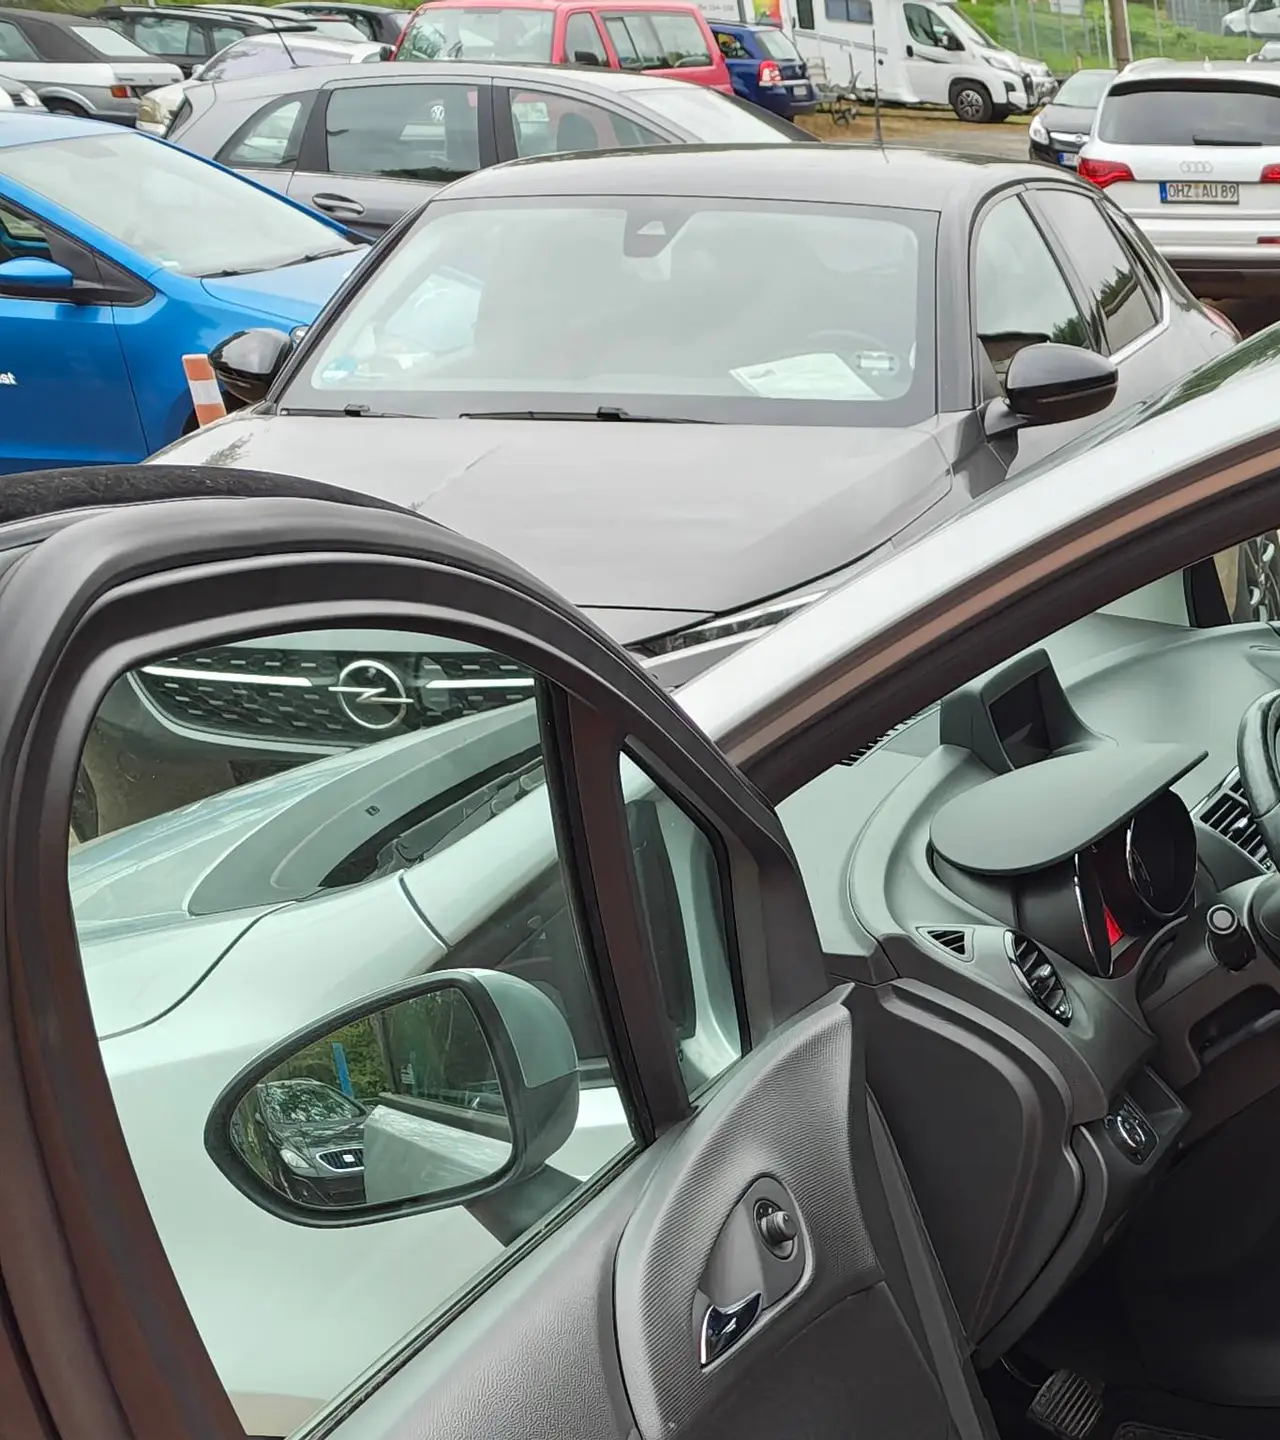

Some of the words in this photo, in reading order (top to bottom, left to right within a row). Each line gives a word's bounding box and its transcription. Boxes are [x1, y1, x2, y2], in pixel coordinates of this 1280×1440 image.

[1168, 183, 1193, 199] OHZ
[1202, 183, 1218, 198] AU
[1220, 184, 1237, 199] 89
